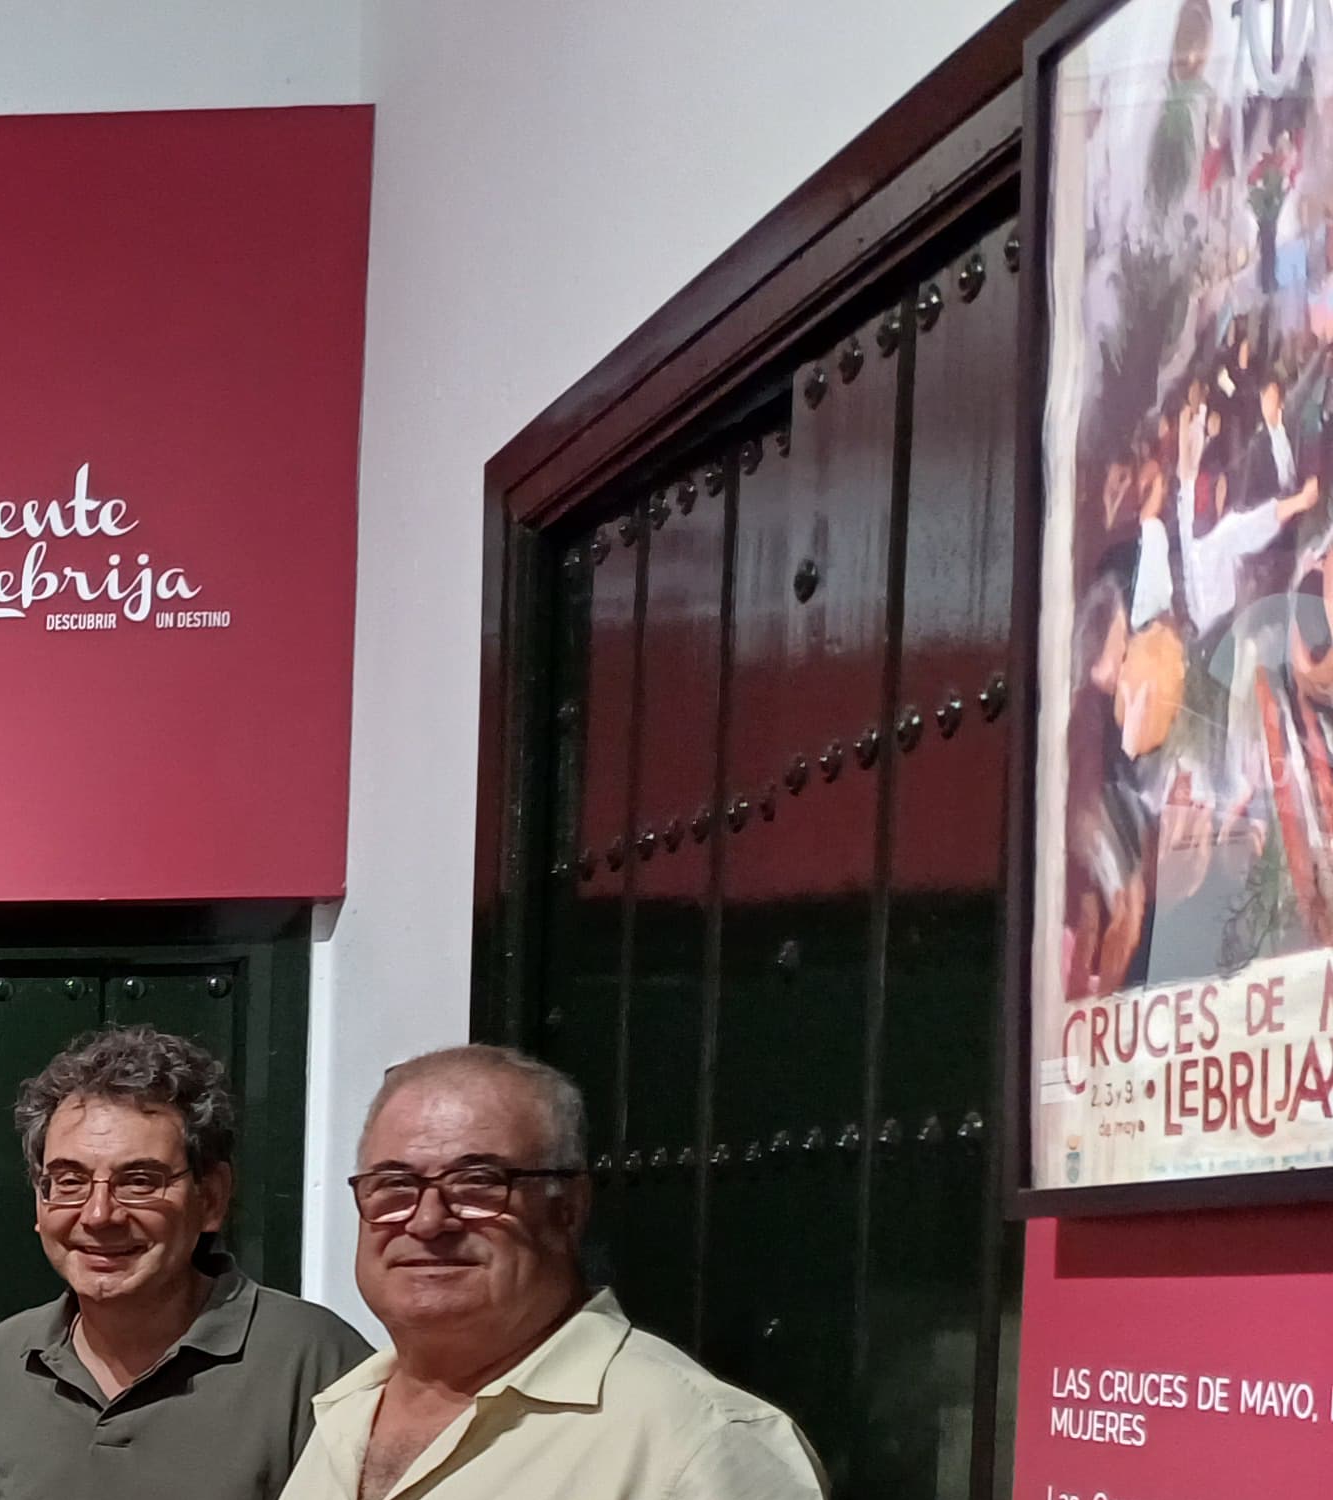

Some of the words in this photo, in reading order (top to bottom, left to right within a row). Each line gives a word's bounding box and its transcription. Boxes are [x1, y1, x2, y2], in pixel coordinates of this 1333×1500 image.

[45, 613, 117, 631] DESCUBRIR
[156, 611, 173, 629] UN
[177, 611, 230, 629] DESTINO
[1062, 985, 1220, 1095] CRUCES
[1246, 976, 1285, 1036] DE
[1052, 1366, 1090, 1400] LAS
[1099, 1370, 1188, 1409] CRUCES
[1197, 1376, 1230, 1412] DE
[1050, 1406, 1146, 1446] MUJERES
